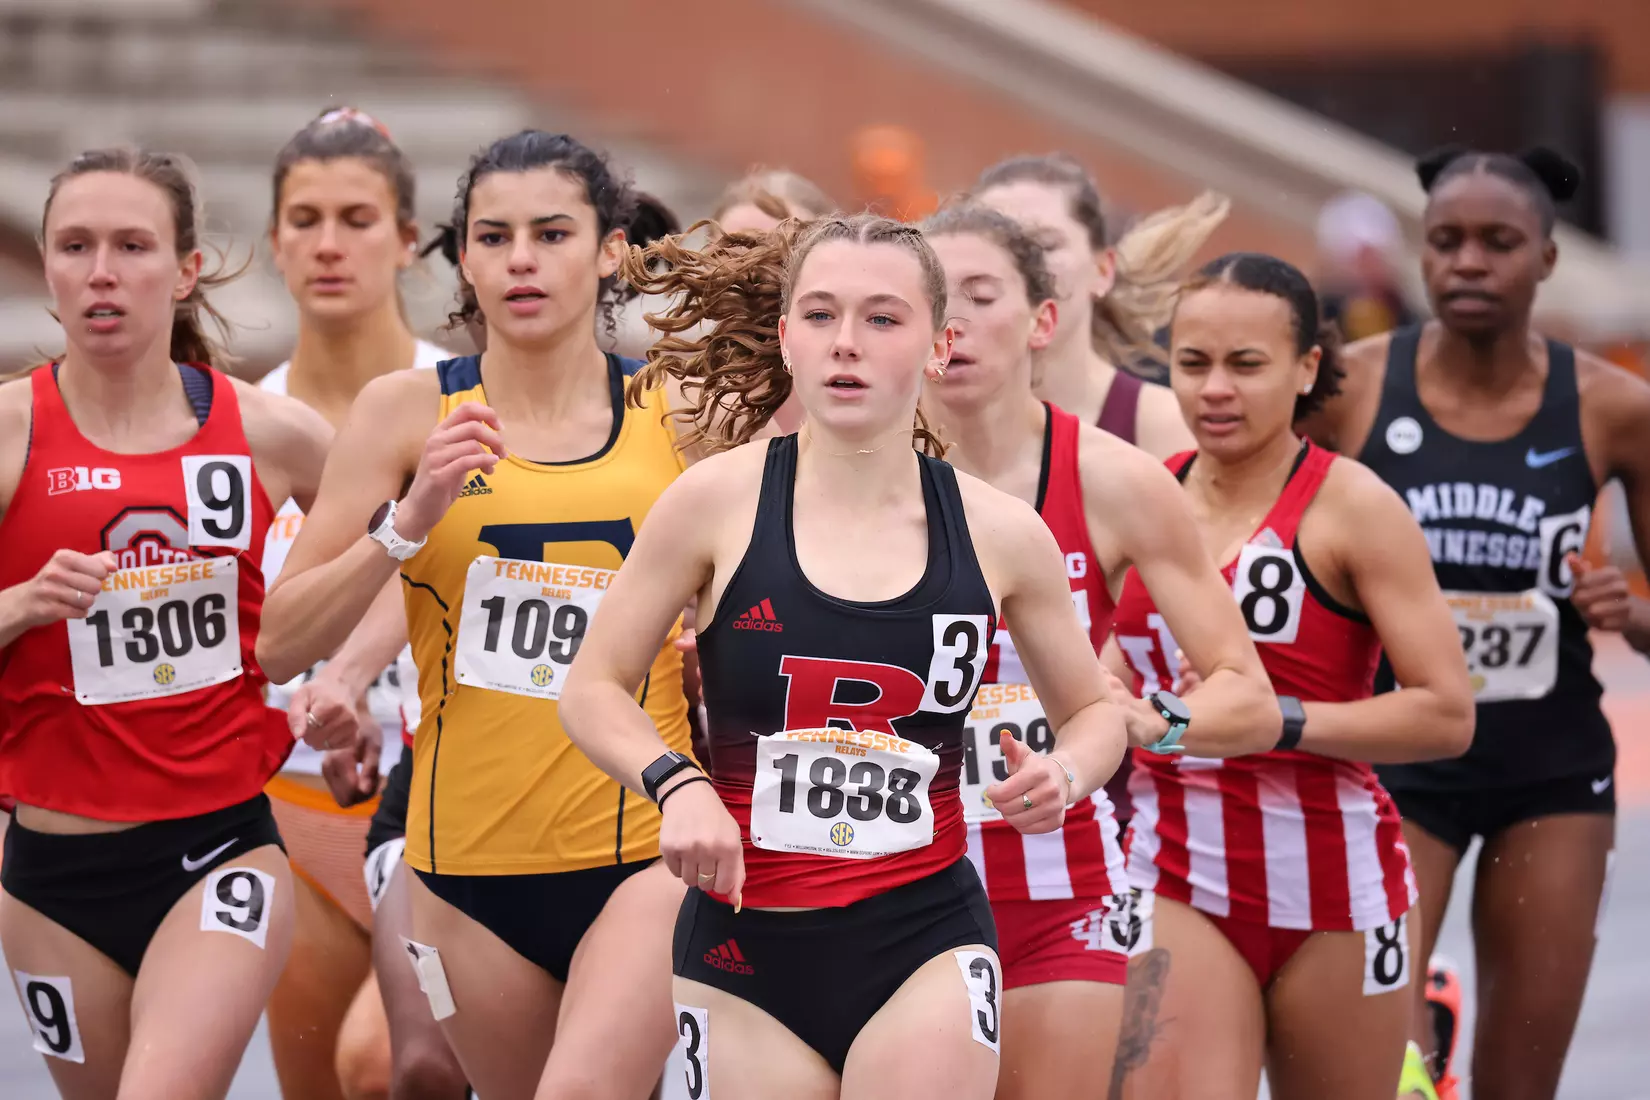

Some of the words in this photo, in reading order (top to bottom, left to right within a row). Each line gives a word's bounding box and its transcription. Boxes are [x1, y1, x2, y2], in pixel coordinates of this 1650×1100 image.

[197, 461, 245, 539] 9
[1406, 482, 1546, 533] MIDDLE
[101, 562, 215, 592] ENNESSEE
[1424, 527, 1541, 570] NNESSE
[1548, 523, 1581, 589] 6
[733, 619, 783, 632] adidas
[1241, 556, 1293, 635] 8
[86, 593, 226, 668] 1306
[481, 595, 588, 665] 109
[934, 620, 979, 707] 3
[778, 654, 927, 737] R
[835, 745, 867, 757] RELAYS
[963, 717, 1056, 785] 139
[773, 753, 922, 824] 1838
[830, 822, 854, 846] SEC
[215, 871, 265, 932] 9
[703, 953, 755, 975] adidas
[1374, 917, 1403, 985] 8
[27, 981, 71, 1054] 9
[968, 957, 997, 1044] 3
[680, 1011, 702, 1100] 3
